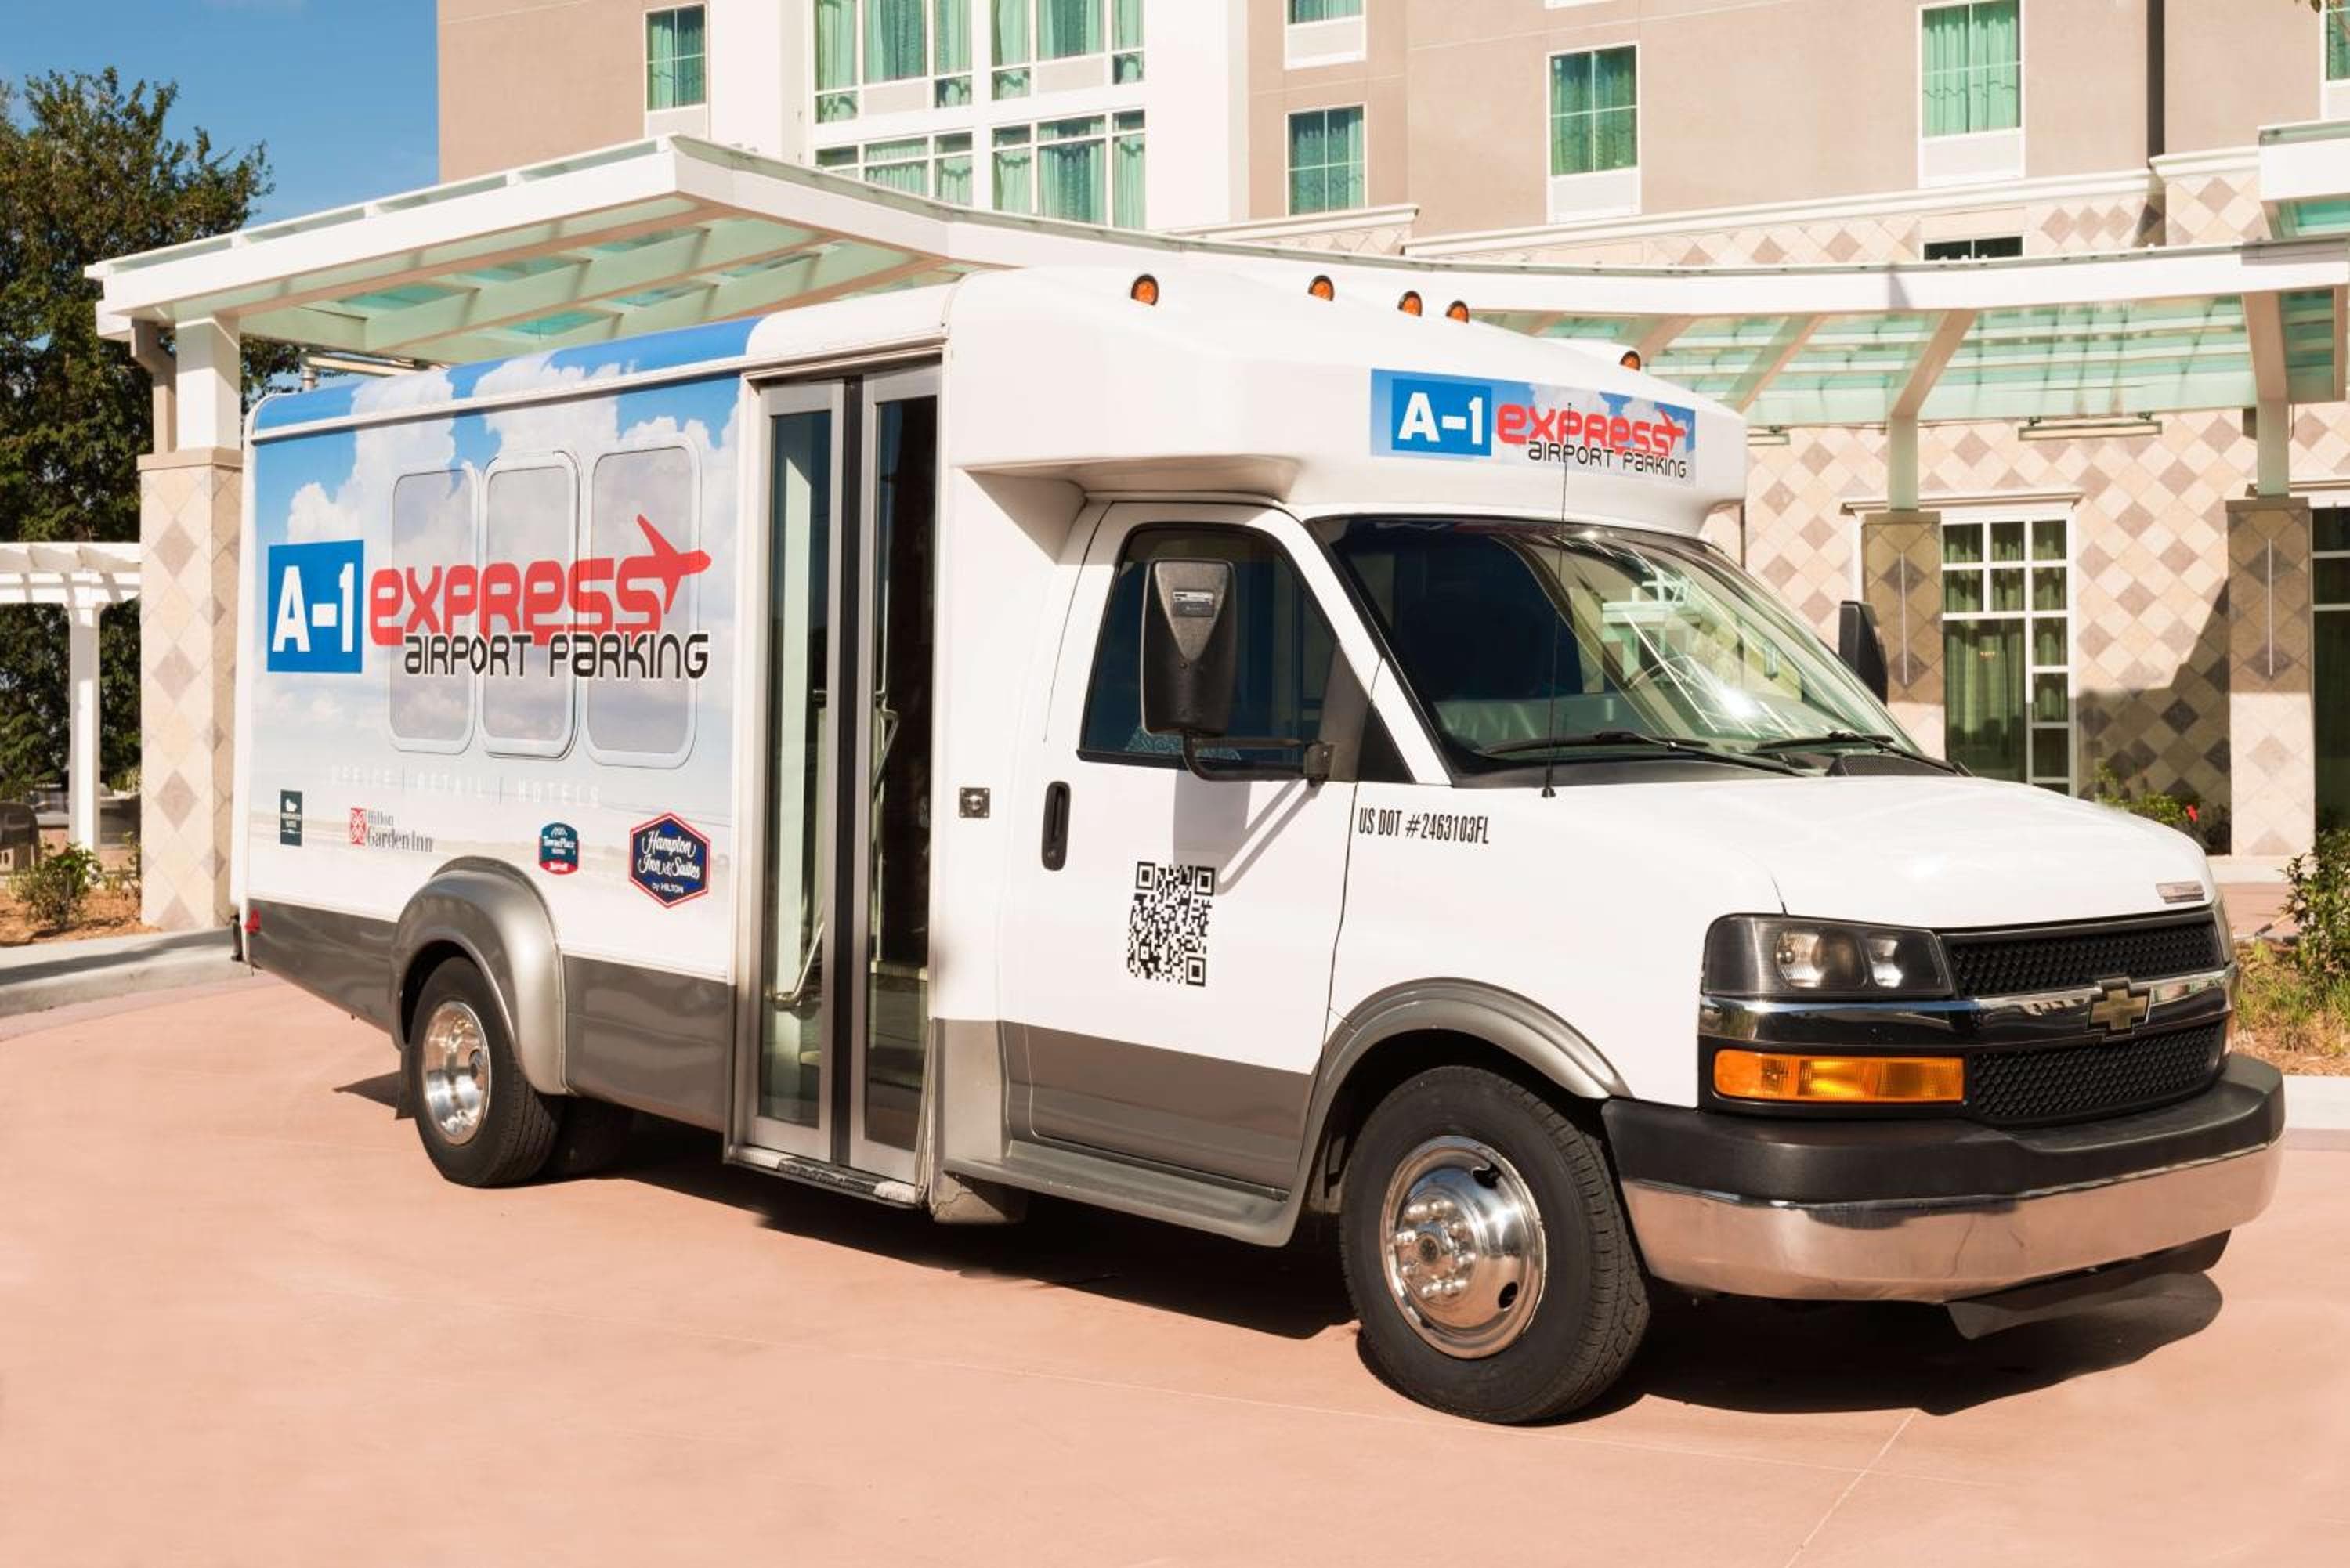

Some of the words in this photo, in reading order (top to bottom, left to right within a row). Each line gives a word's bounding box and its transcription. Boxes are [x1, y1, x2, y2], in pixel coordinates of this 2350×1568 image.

[1397, 392, 1483, 446] A-1
[272, 562, 355, 652] A-1
[642, 829, 696, 858] Hampton
[1358, 807, 1376, 834] US
[1378, 809, 1403, 837] DOT
[1405, 812, 1490, 844] #2463103FL
